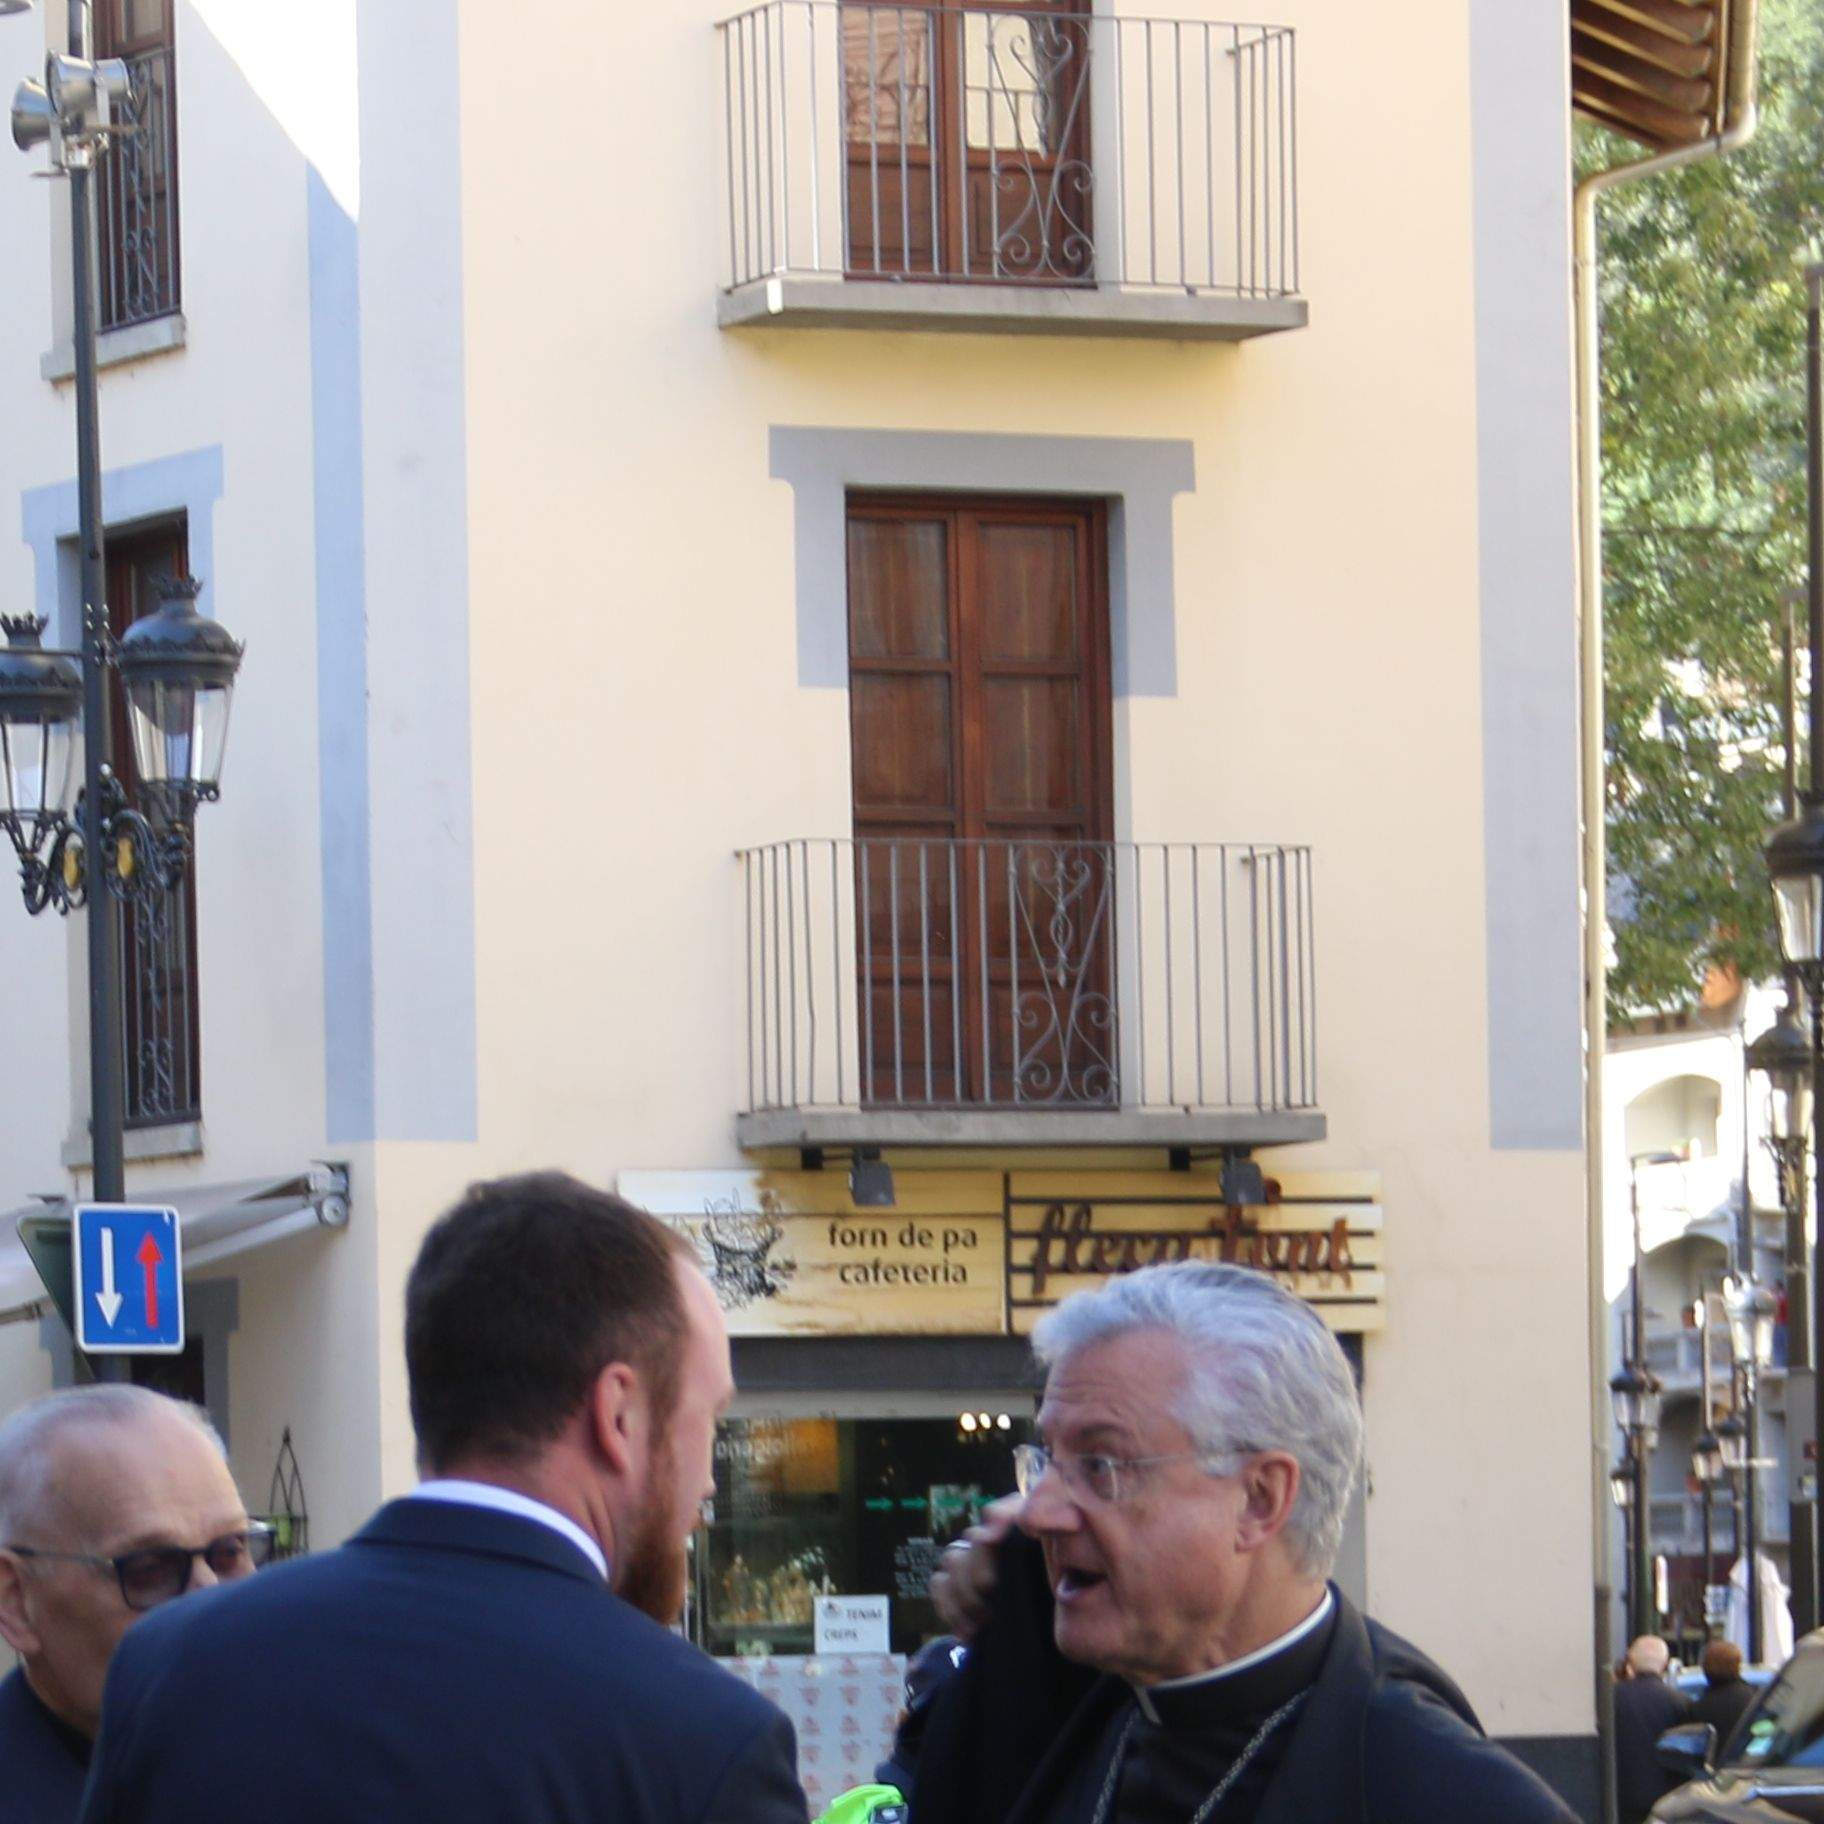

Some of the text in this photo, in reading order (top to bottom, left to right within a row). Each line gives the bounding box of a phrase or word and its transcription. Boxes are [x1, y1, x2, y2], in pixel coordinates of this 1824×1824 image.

[828, 1221, 979, 1254] forn de pa
[838, 1257, 968, 1285] cafeteria
